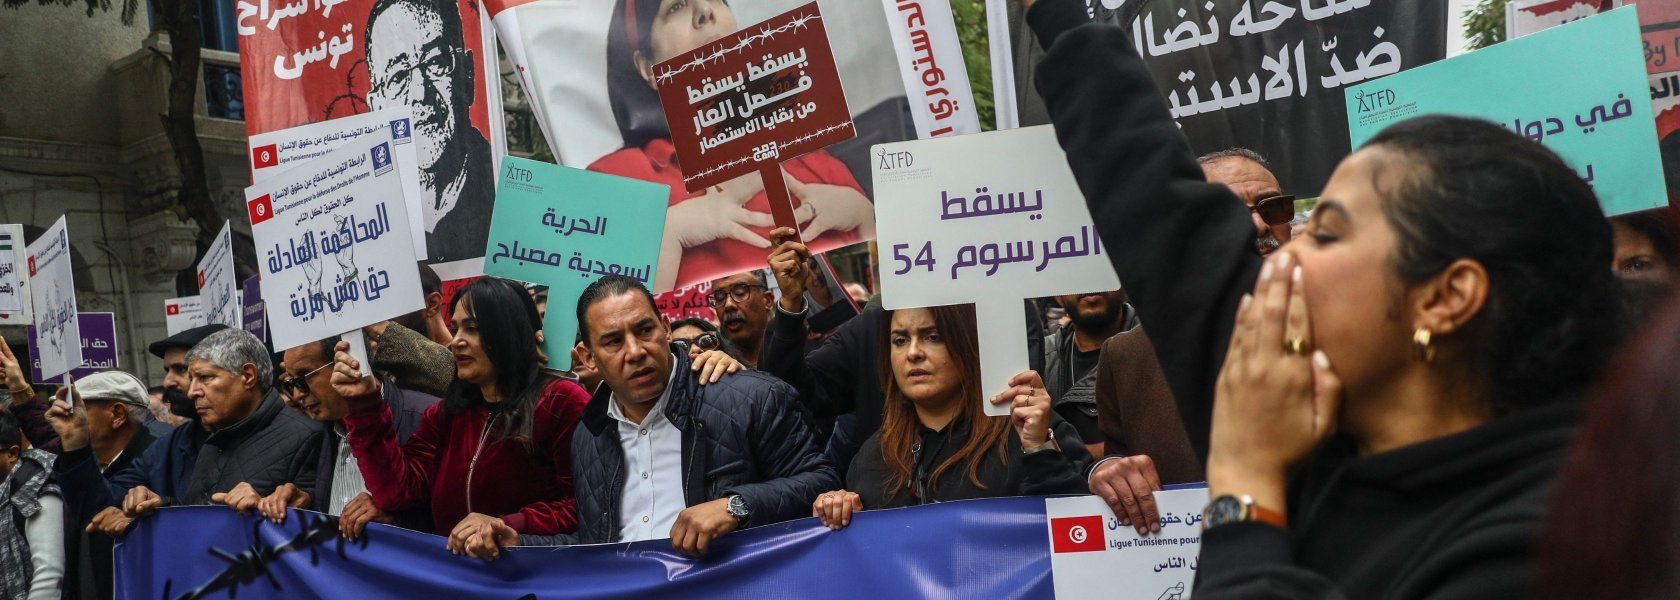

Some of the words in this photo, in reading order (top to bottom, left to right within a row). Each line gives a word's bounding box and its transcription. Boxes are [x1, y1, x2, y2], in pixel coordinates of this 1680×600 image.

[274, 23, 354, 80] تونس
[746, 47, 809, 82] يسقط
[686, 71, 746, 104] يسقط
[796, 102, 817, 119] من
[1355, 89, 1395, 113] ATFD
[693, 99, 735, 136] العار
[761, 107, 794, 131] بقايا
[1575, 93, 1632, 134] في
[299, 139, 312, 149] حقوق
[314, 137, 322, 146] عن
[699, 117, 760, 155] الاستعمار
[349, 153, 366, 168] الرابطة
[877, 148, 914, 170] ATFD
[313, 171, 327, 187] للدفاع
[327, 161, 348, 179] التونسية
[506, 162, 533, 182] ATFD
[290, 182, 303, 195] حقوق
[304, 180, 312, 189] عن
[324, 199, 341, 214] الحقوق
[343, 195, 354, 207] كل
[940, 187, 1043, 221] يسقط
[295, 212, 308, 226] الناس
[310, 206, 322, 219] لكل
[541, 207, 607, 236] الحرية
[321, 202, 390, 256] المحاكمة
[268, 230, 317, 275] العادلة
[492, 240, 561, 267] مصباح
[893, 240, 936, 276] 54
[951, 225, 1101, 280] المرسوم
[568, 251, 650, 283] لسعدية
[327, 274, 359, 314] مش
[364, 266, 391, 301] حق
[92, 338, 109, 348] حق
[78, 358, 114, 369] المحاك
[1160, 512, 1181, 527] حقو
[1185, 512, 1202, 526] عن
[1110, 539, 1132, 550] Ligue
[1133, 536, 1177, 547] Tunisienne
[1180, 536, 1200, 547] pour
[1153, 556, 1186, 572] الناس
